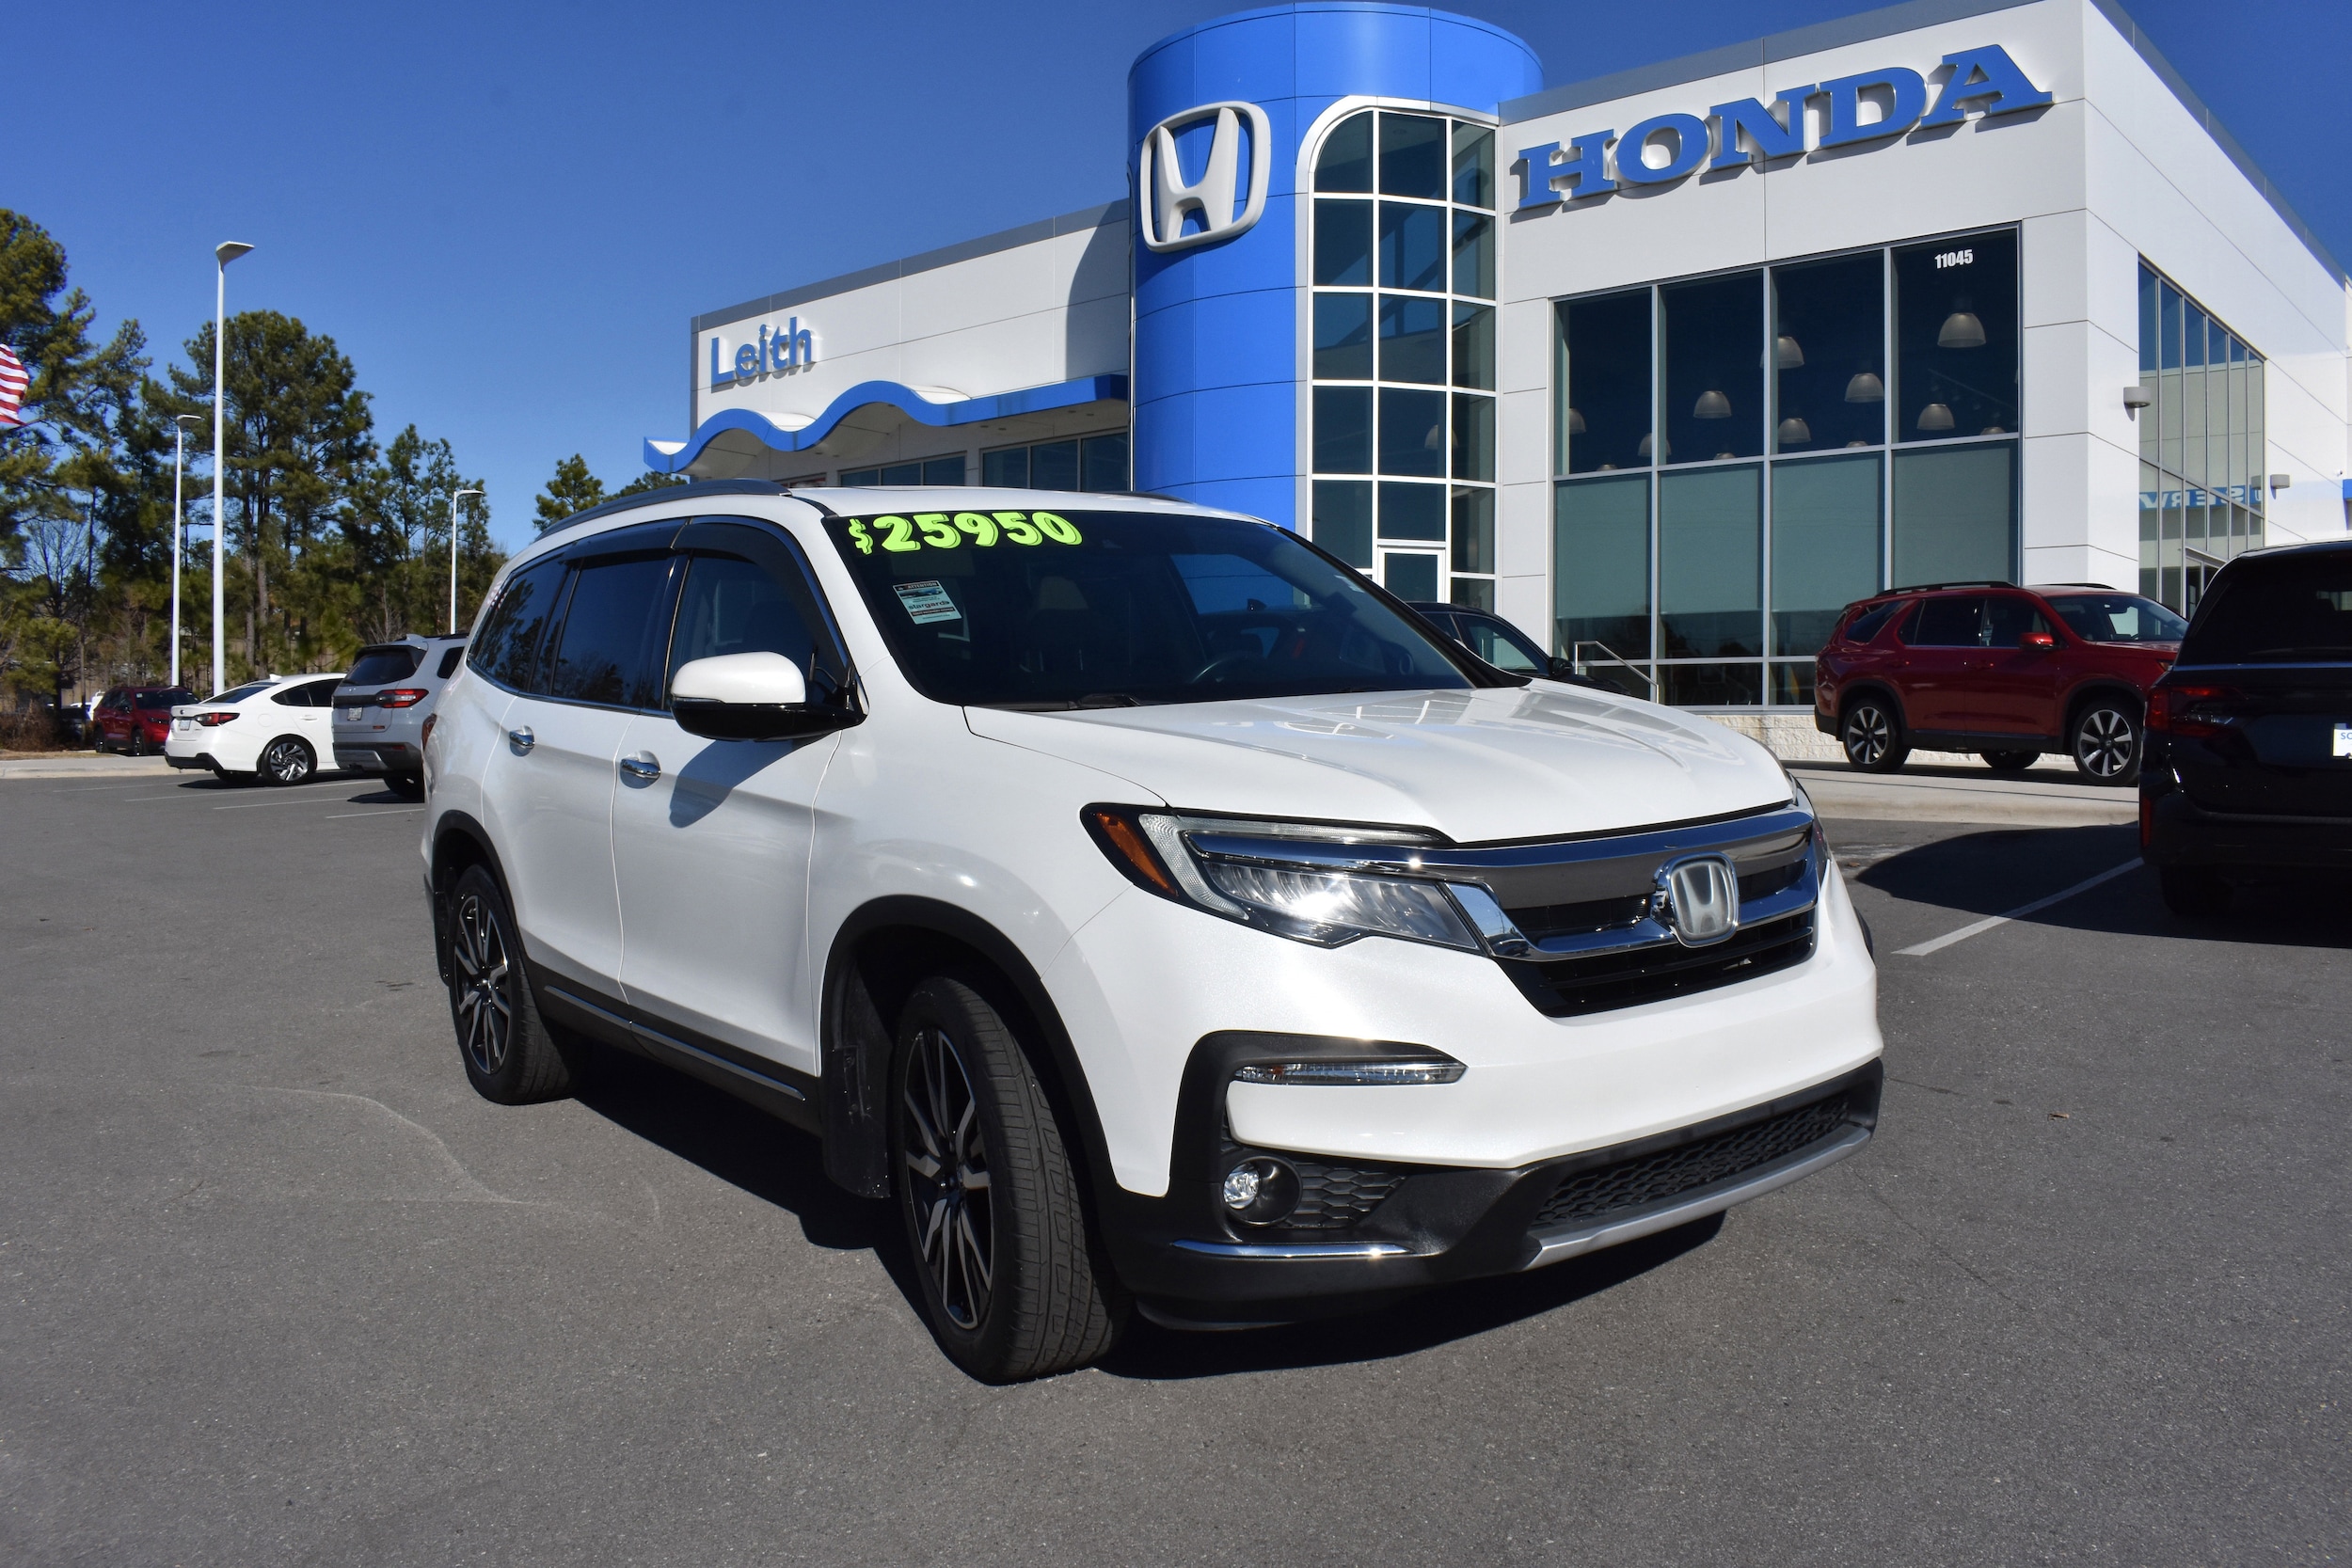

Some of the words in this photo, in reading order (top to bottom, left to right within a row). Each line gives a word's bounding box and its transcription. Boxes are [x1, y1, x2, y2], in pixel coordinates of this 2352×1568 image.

[1518, 44, 2053, 209] HONDA
[1934, 249, 1974, 269] 11045
[711, 316, 813, 385] Leith
[848, 512, 1083, 555] $25950
